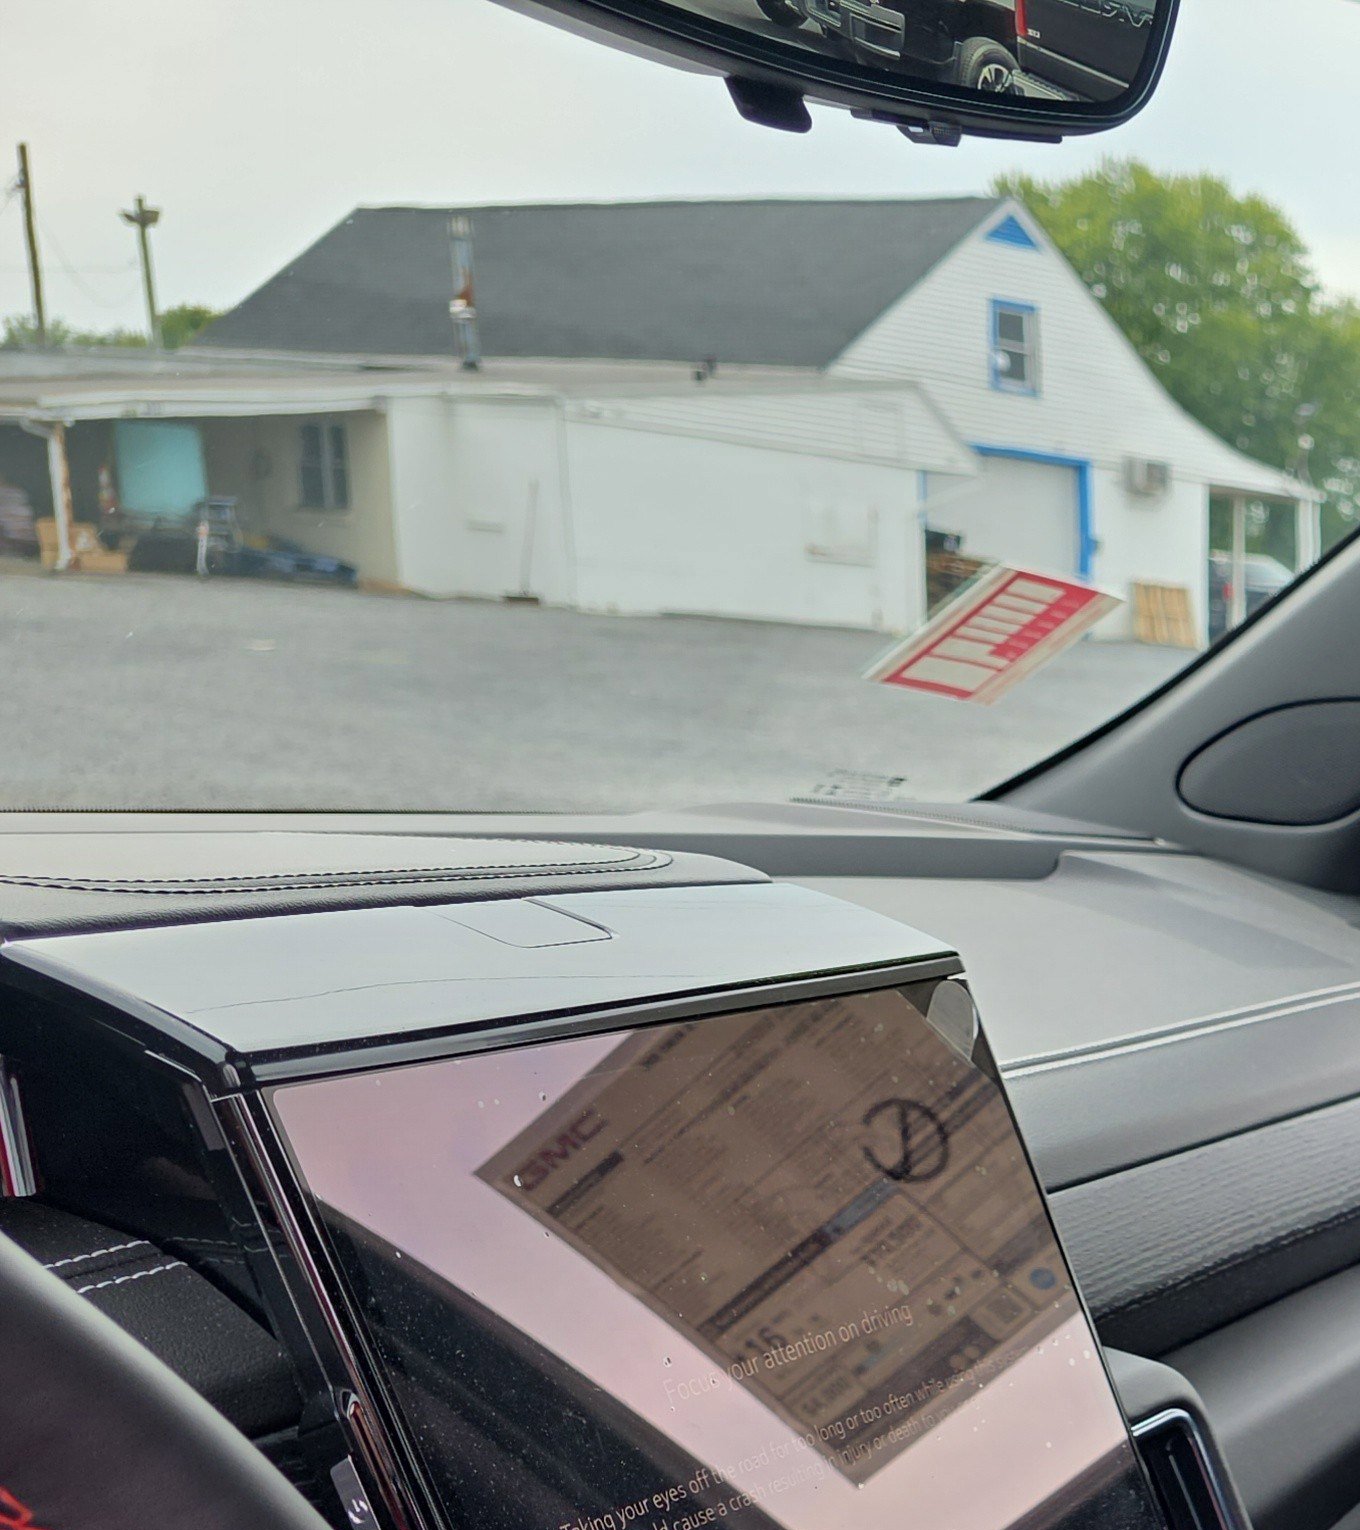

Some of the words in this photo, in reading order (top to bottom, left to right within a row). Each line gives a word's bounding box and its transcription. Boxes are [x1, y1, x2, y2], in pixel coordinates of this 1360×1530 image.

[662, 1371, 720, 1404] Focus
[722, 1355, 760, 1388] your
[763, 1326, 837, 1372] attention
[838, 1321, 860, 1343] on
[860, 1301, 913, 1338] driving
[616, 1496, 651, 1530] your
[652, 1485, 688, 1513] eyes
[688, 1469, 710, 1495] off
[737, 1448, 770, 1475] road
[769, 1441, 791, 1463] for
[790, 1432, 815, 1453] too
[814, 1410, 846, 1443] long
[845, 1411, 860, 1432] or
[859, 1402, 883, 1425] too
[883, 1389, 915, 1416] often
[717, 1502, 728, 1517] a
[728, 1483, 768, 1513] crash
[767, 1461, 825, 1498] resulting
[873, 1431, 890, 1451] or
[889, 1416, 921, 1442] death
